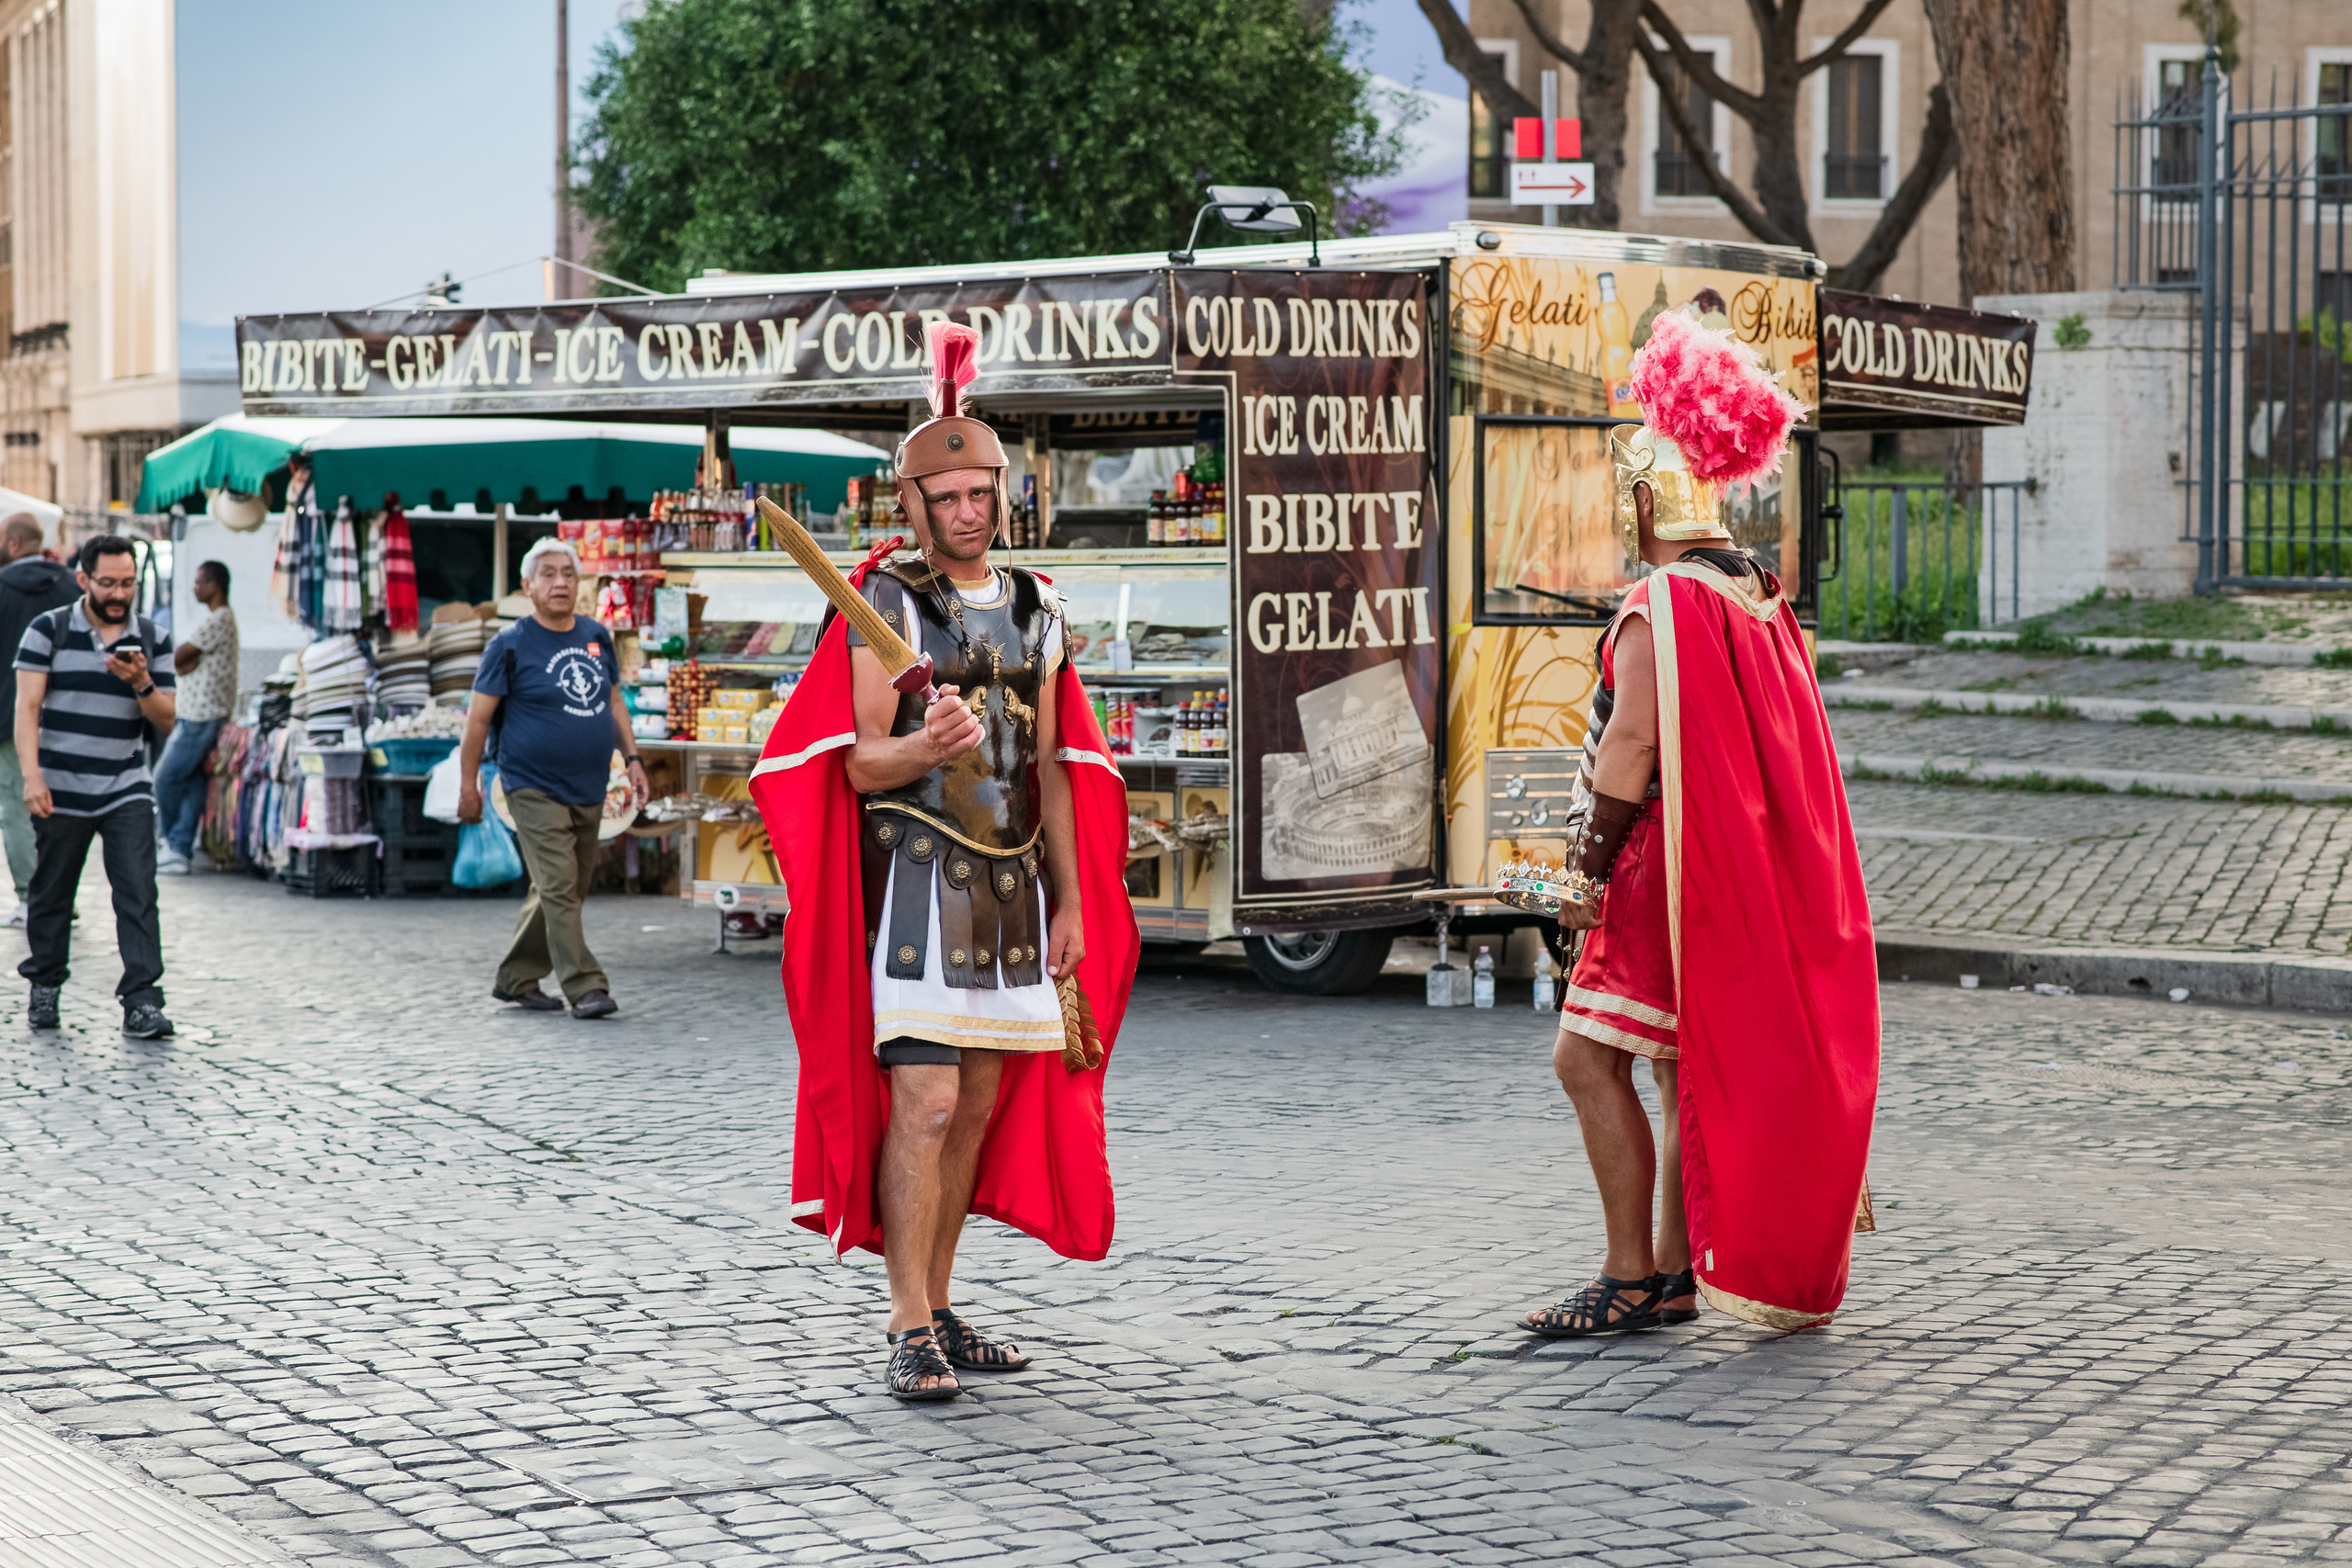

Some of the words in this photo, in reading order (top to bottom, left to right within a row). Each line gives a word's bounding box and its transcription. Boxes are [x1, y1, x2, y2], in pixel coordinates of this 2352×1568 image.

[966, 296, 1160, 365] DRINKS
[1185, 296, 1282, 358] COLD
[1288, 298, 1421, 359] DRINKS
[1450, 262, 1590, 354] Gelati
[1823, 313, 1906, 378] COLD
[1911, 327, 2028, 396] DRINKS
[1242, 395, 1299, 457] ICE
[1306, 394, 1425, 457] CREAM
[1246, 491, 1423, 554] BIBITE
[1247, 587, 1435, 654] GELATI
